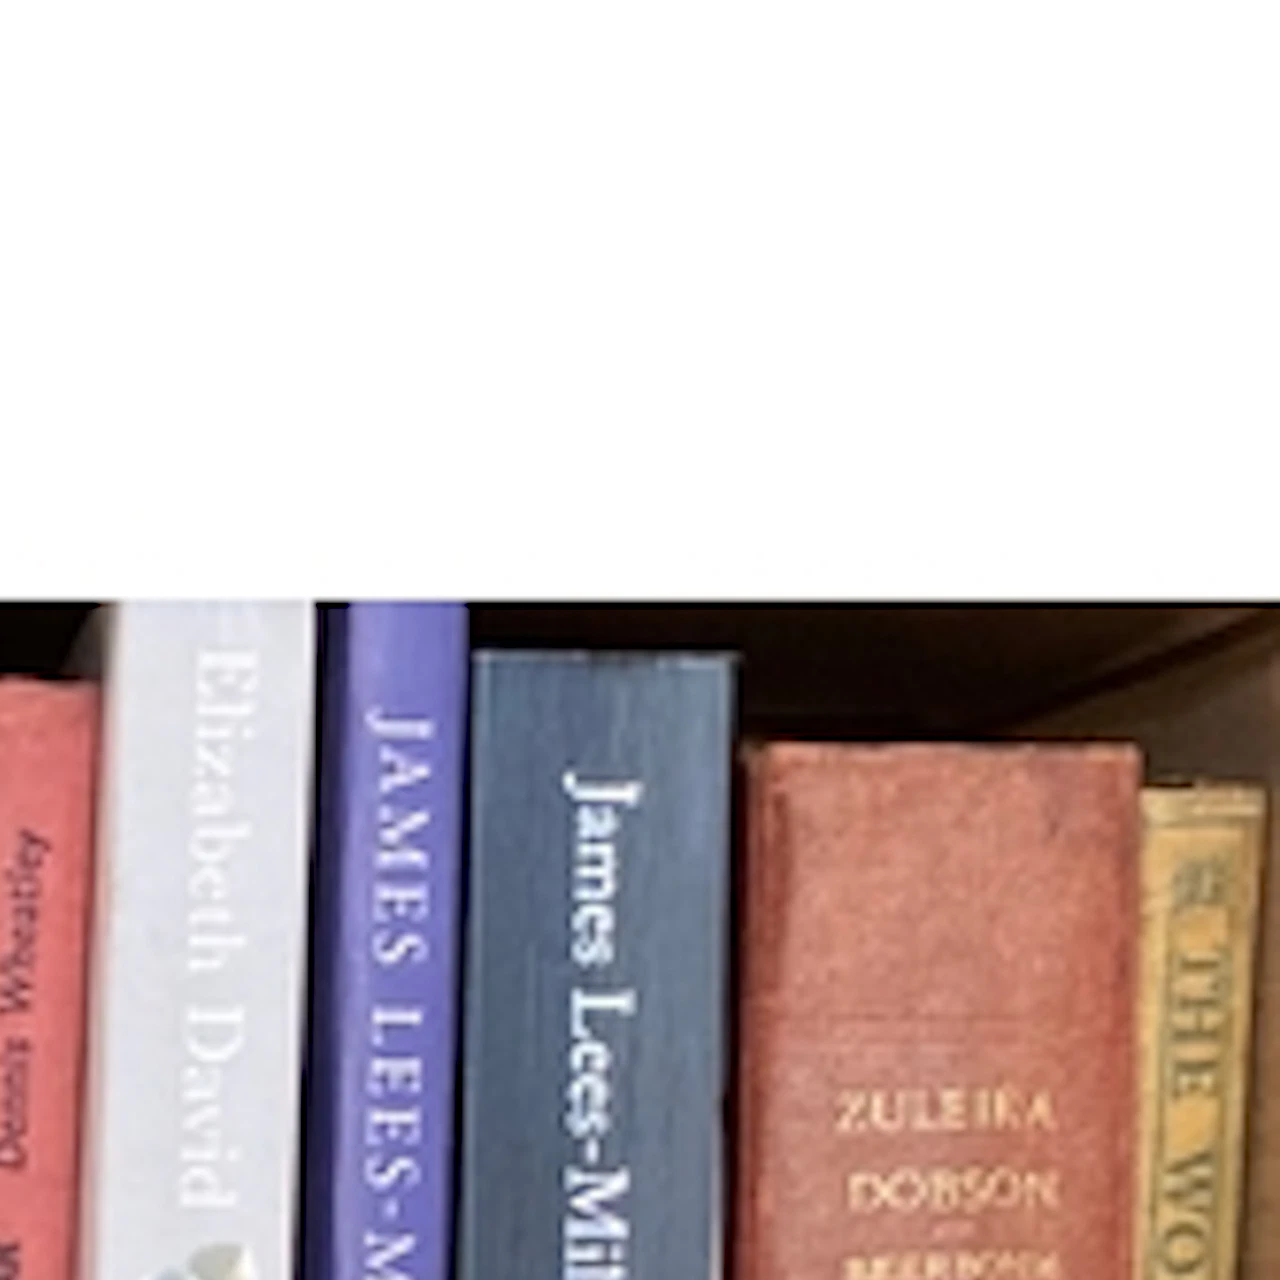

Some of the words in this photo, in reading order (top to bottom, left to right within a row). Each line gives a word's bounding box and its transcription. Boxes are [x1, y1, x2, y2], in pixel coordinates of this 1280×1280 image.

[183, 646, 261, 975] Elizabeth
[363, 704, 438, 969] JAMES
[560, 769, 645, 970] James
[177, 999, 246, 1212] David
[835, 1084, 1061, 1133] ZULEIKA
[1164, 950, 1233, 1100] THE
[846, 1165, 1063, 1215] DOBSON
